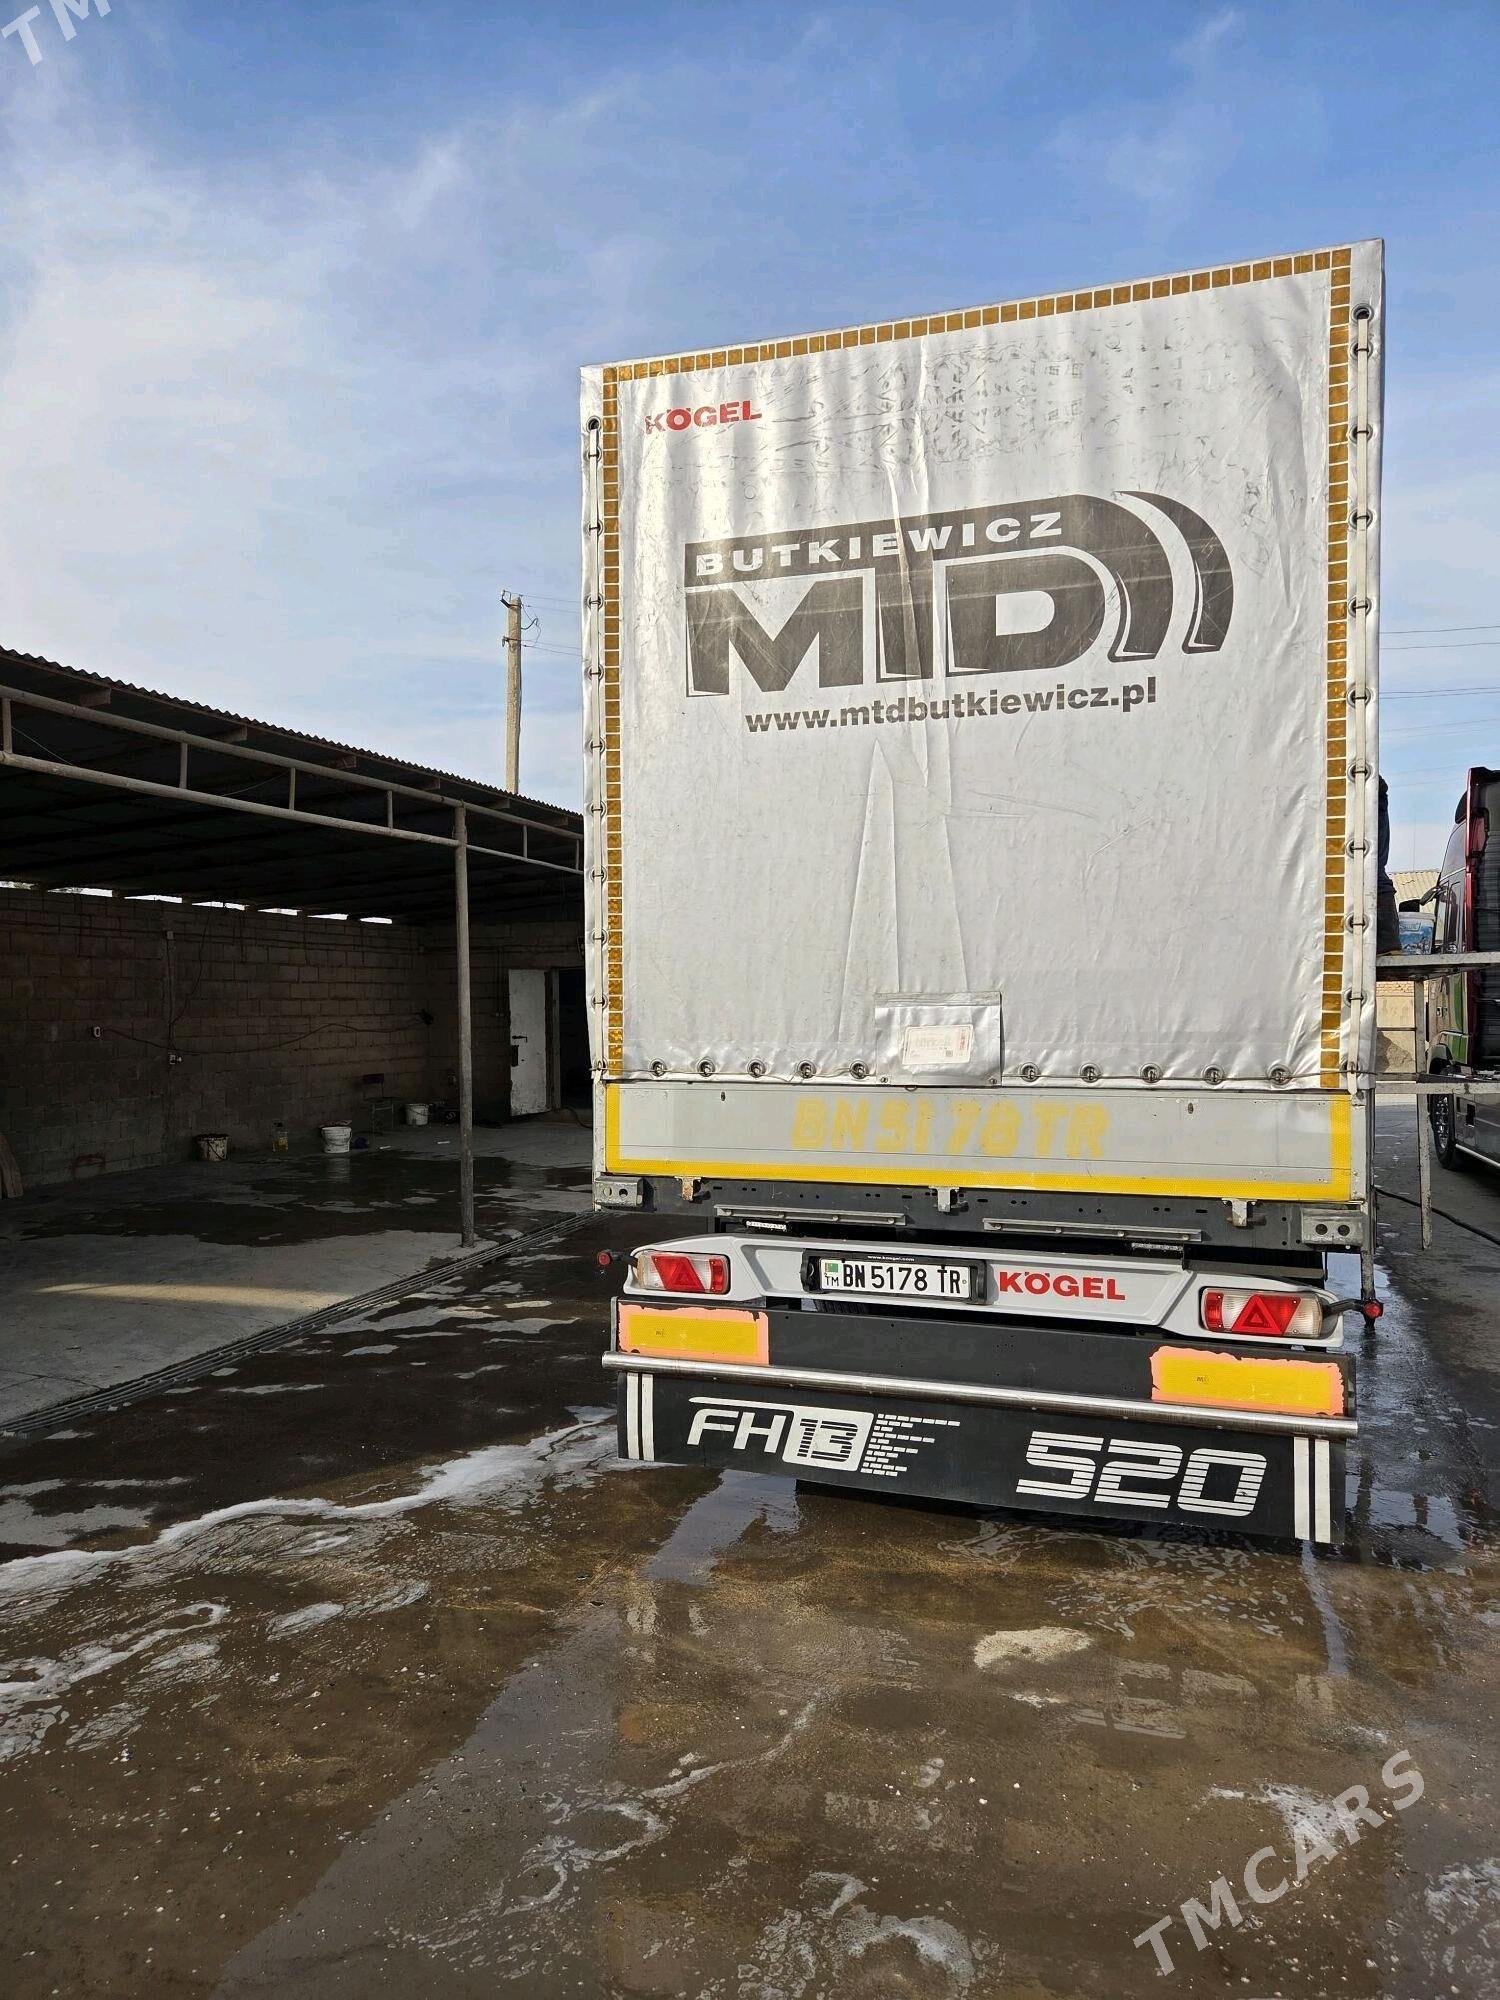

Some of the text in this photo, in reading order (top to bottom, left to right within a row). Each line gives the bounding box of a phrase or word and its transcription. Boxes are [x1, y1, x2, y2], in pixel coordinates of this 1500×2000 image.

[695, 511, 1062, 577] BUTKIEWICZ
[745, 677, 1157, 733] www.mtdbutkiewicz.pl
[843, 1263, 866, 1288] BN
[871, 1265, 928, 1292] 5178
[937, 1267, 961, 1295] TR
[1016, 1431, 1268, 1517] 520
